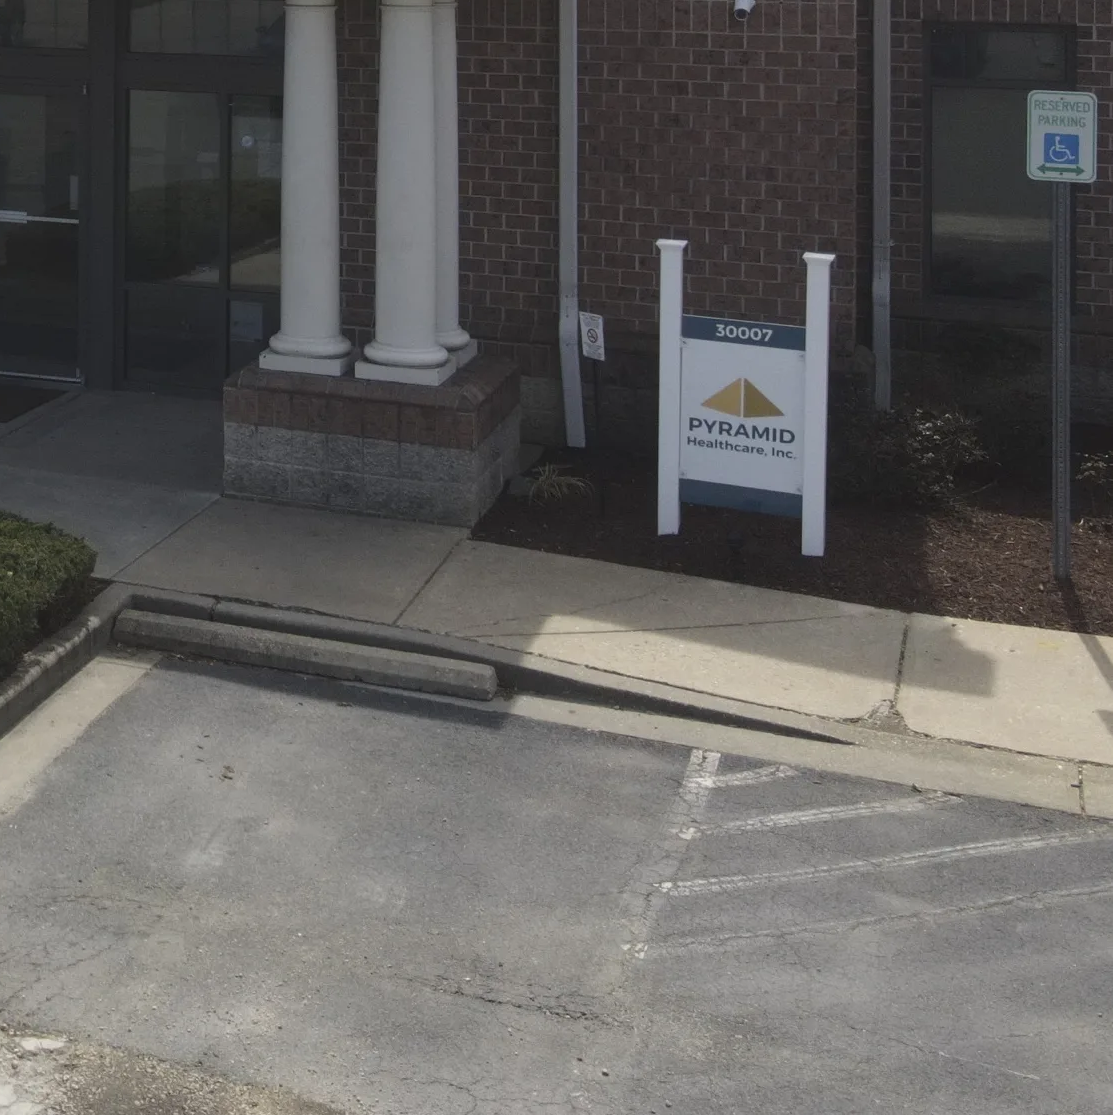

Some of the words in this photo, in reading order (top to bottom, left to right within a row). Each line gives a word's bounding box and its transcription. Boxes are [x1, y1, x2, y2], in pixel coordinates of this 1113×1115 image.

[1033, 99, 1091, 113] RESERVED
[1038, 115, 1087, 128] PARKING
[715, 323, 773, 342] 30007
[688, 417, 796, 445] PYRAMID
[686, 436, 768, 457] Healthcare,
[771, 447, 797, 460] Inc.
